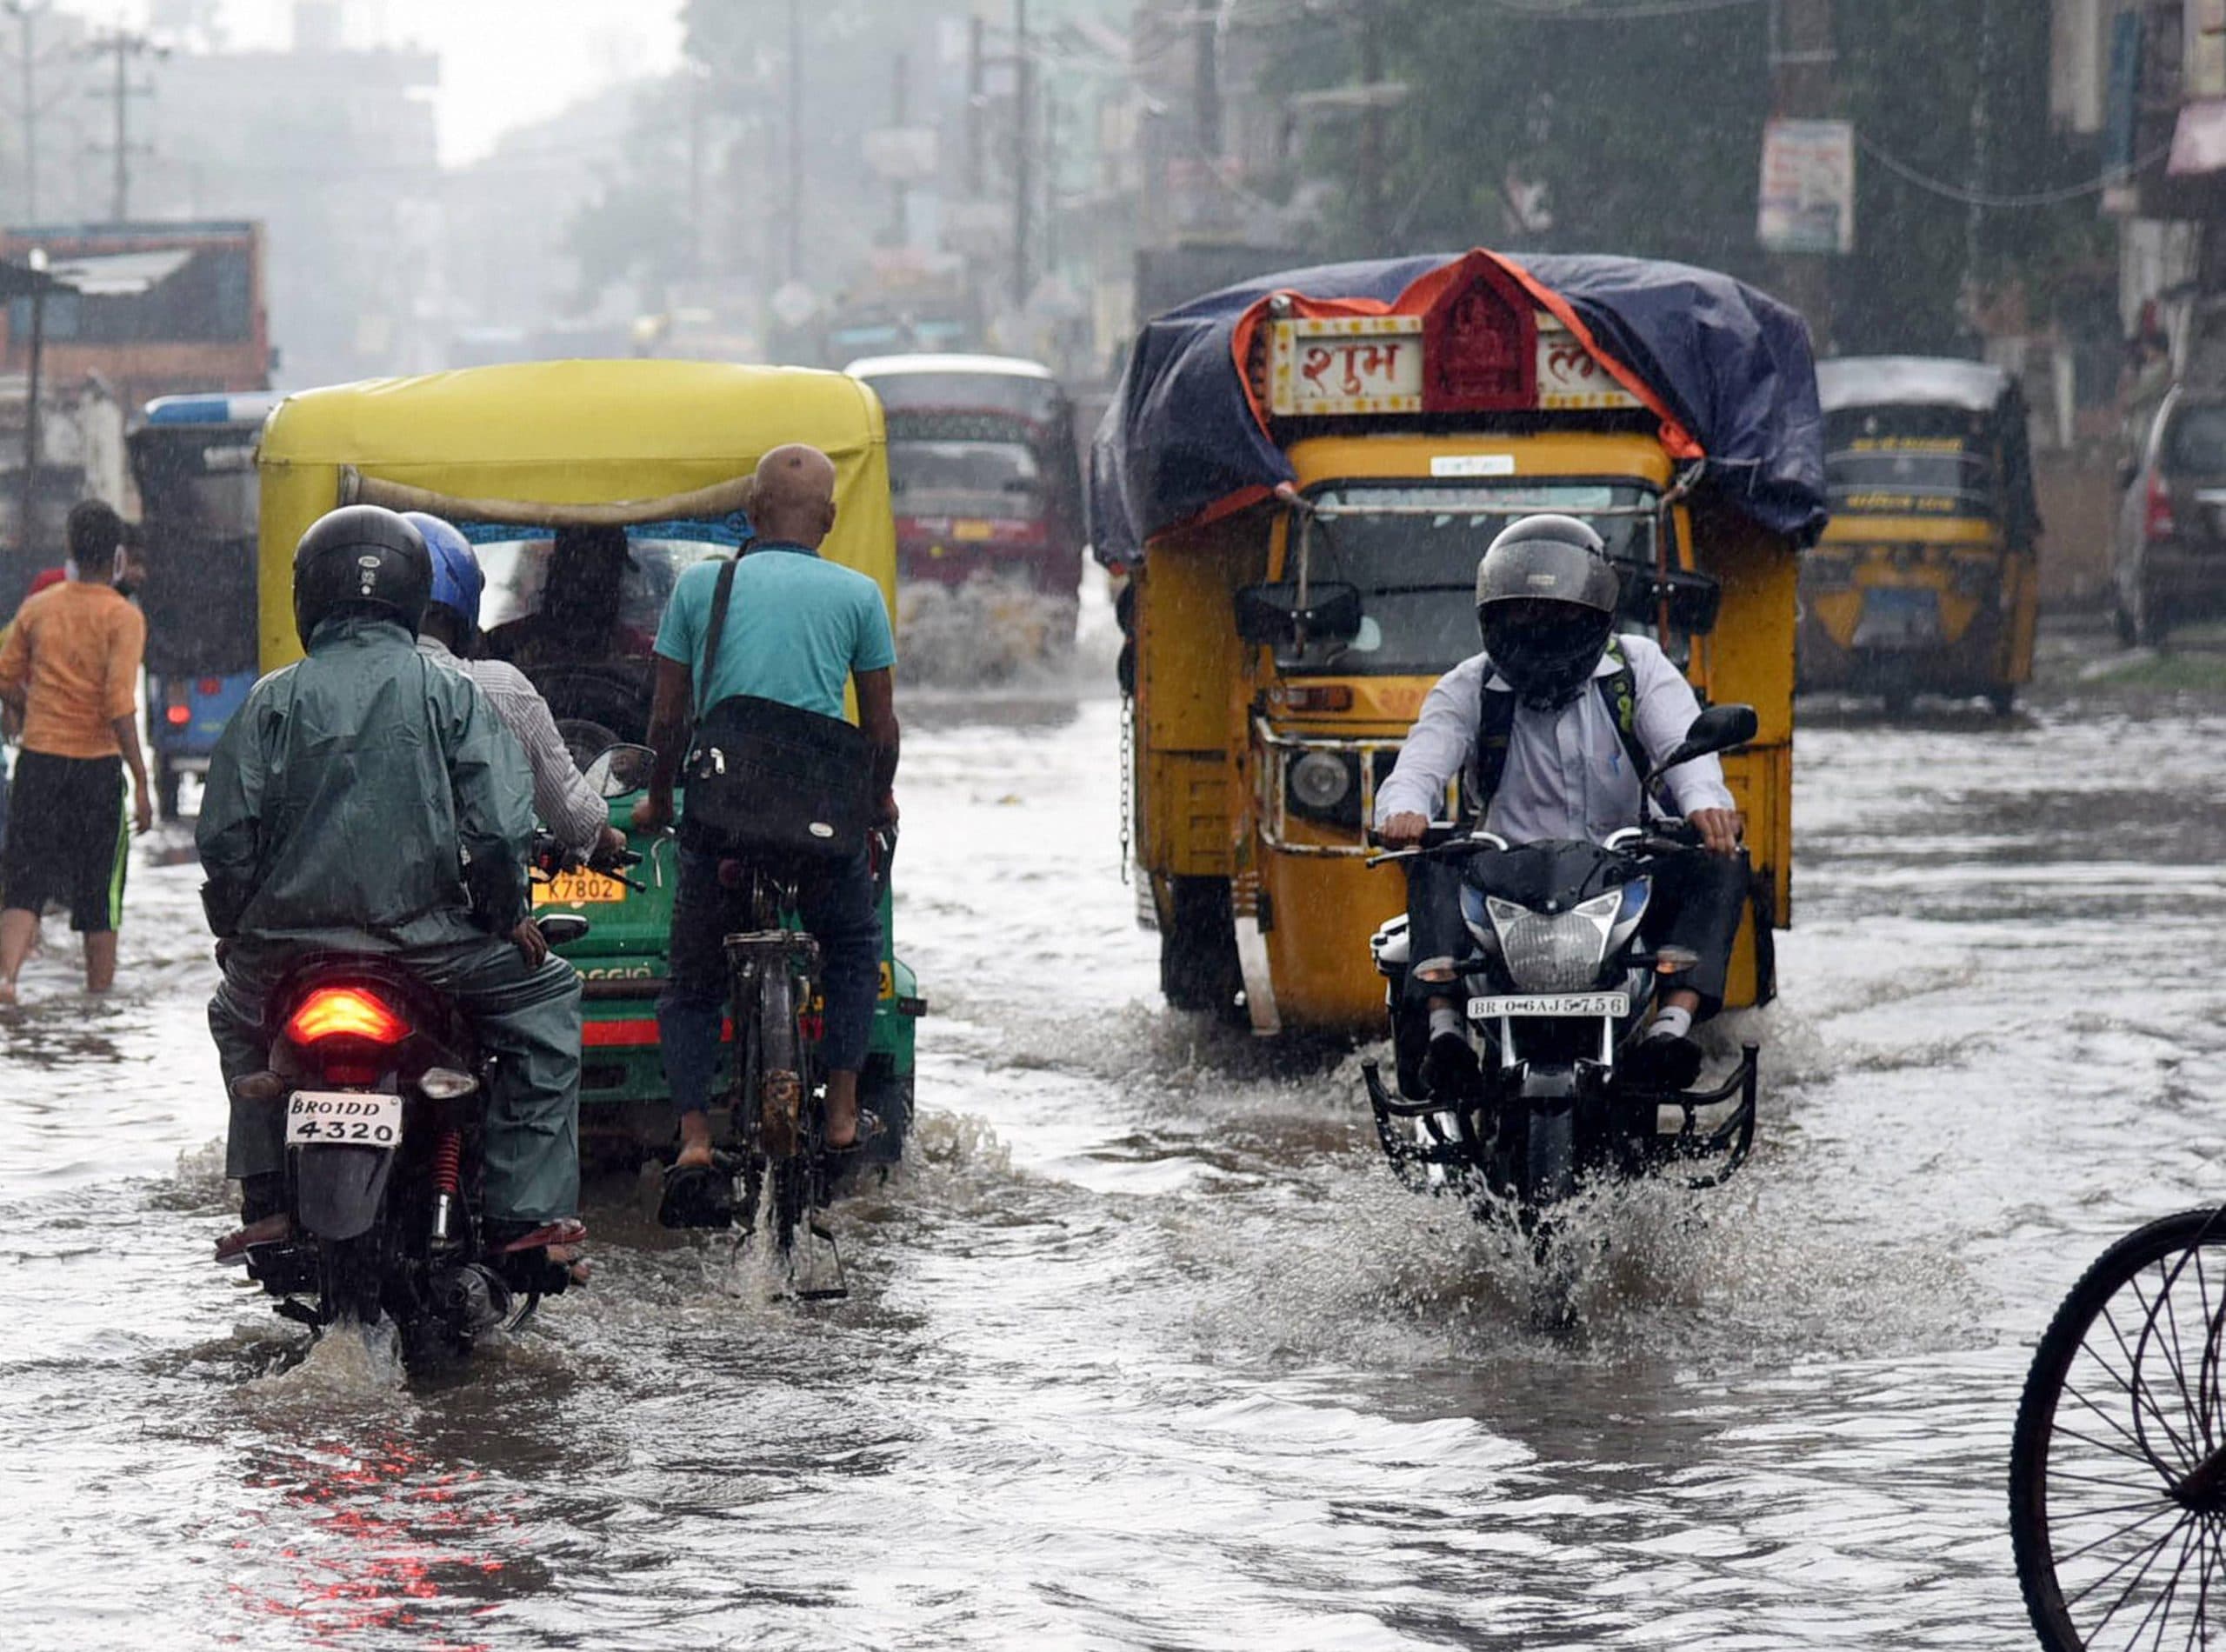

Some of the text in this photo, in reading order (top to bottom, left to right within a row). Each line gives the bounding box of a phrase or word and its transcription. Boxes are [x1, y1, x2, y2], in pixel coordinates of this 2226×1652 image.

[1302, 343, 1401, 396] शुभ
[549, 879, 613, 899] K7802
[297, 1121, 393, 1142] 4320
